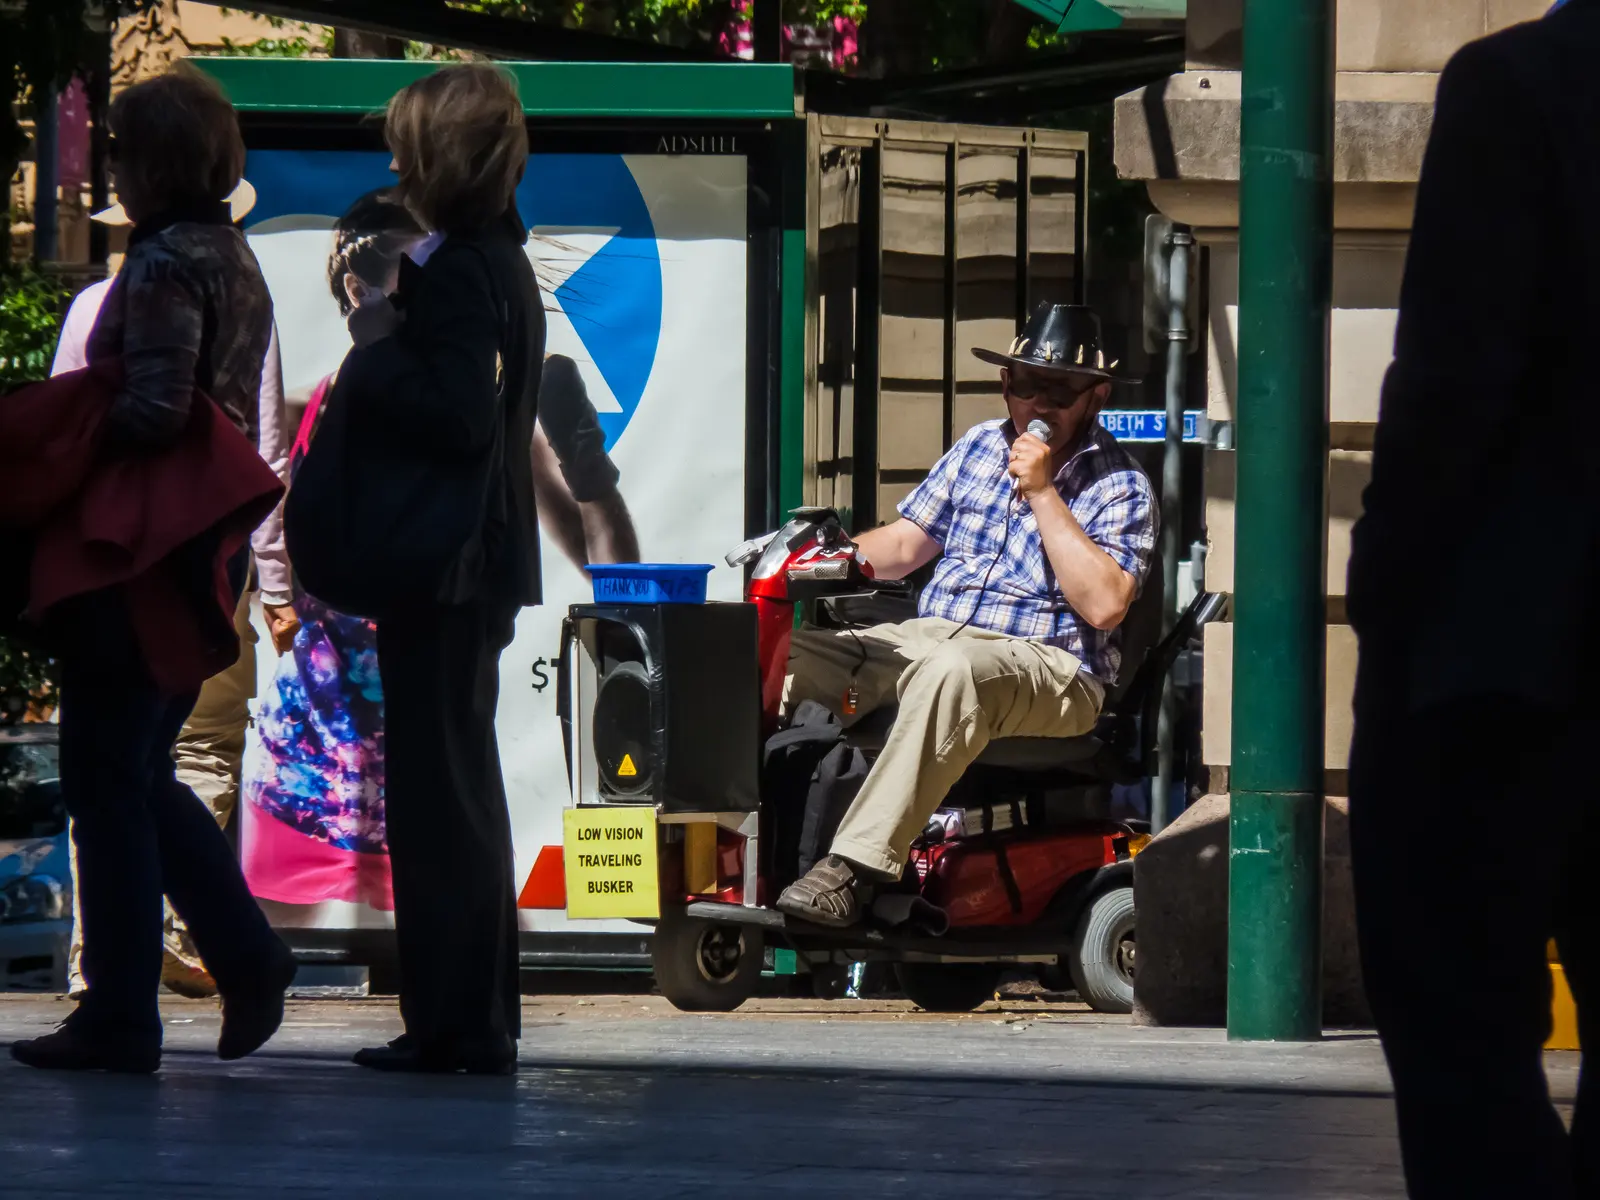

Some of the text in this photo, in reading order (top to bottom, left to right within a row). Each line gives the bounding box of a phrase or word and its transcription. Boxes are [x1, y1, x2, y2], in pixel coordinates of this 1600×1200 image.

[1153, 414, 1166, 431] S
[597, 577, 632, 596] THANK
[633, 578, 650, 596] YOU
[578, 827, 643, 841] LOW VISION
[578, 854, 642, 867] TRAVELING
[588, 881, 634, 893] BUSKER
